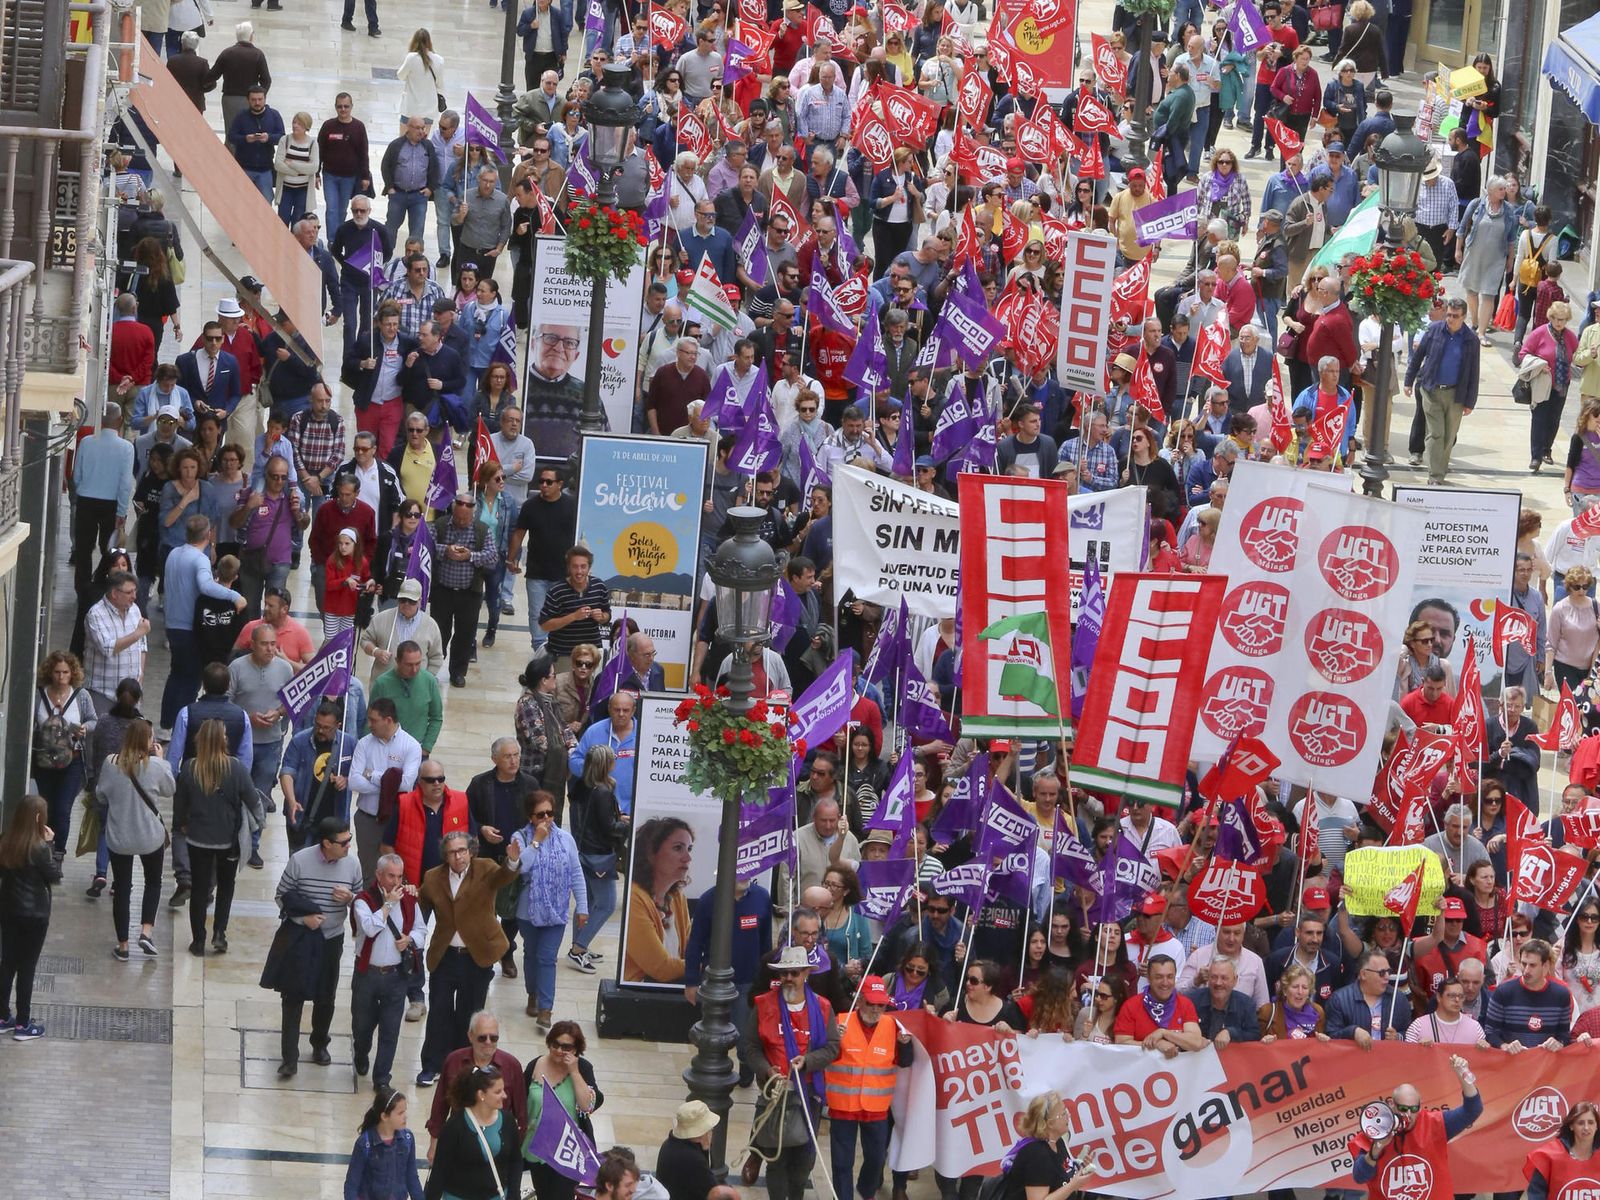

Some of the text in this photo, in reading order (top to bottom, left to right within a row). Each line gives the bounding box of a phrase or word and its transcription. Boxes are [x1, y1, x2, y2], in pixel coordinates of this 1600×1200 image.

[977, 149, 1007, 170] UGT
[544, 277, 580, 287] ACABAR
[582, 279, 594, 288] CO
[542, 297, 572, 307] SALUD
[543, 288, 593, 298] ESTIGMA DE
[1066, 238, 1107, 368] CCOO
[953, 310, 991, 345] CCOO
[962, 337, 982, 357] Málaga
[1066, 367, 1096, 378] málaga
[612, 451, 678, 464] 28 DE ABRIL DE 2018
[616, 473, 670, 490] FESTIVAL
[595, 483, 688, 515] Solidario
[1425, 522, 1489, 533] AUTOESTIMA
[629, 532, 654, 547] Soles
[876, 524, 925, 552] SIN
[1336, 534, 1384, 560] UGT
[1426, 533, 1489, 544] EMPLEO SON
[628, 546, 666, 567] Málaga
[1436, 545, 1500, 556] PARA EVITAR
[1257, 558, 1289, 571] Málaga
[1418, 555, 1477, 567] EXCLUSIÓN”
[903, 581, 932, 594] UNA
[1337, 586, 1369, 600] Málaga
[1238, 589, 1286, 620] UGT
[1322, 615, 1369, 644] UGT
[1236, 643, 1268, 655] Málaga
[1097, 580, 1201, 780] CCOO
[1321, 669, 1352, 683] Málaga
[1216, 674, 1267, 704] UGT
[1305, 698, 1351, 730] UGT
[653, 734, 680, 744] “DAR
[1216, 726, 1248, 739] Málaa
[652, 747, 680, 757] PARA
[1304, 751, 1336, 765] Málaga
[651, 759, 685, 770] MÍA ES
[1205, 864, 1256, 894] UGT
[1201, 908, 1241, 920] Andalucía
[937, 1036, 1019, 1075] mayo
[943, 1061, 1025, 1108] 2018
[1172, 1055, 1311, 1161] ganar
[1276, 1086, 1346, 1123] Igualdad
[1521, 1094, 1562, 1117] UGT
[1293, 1113, 1341, 1139] Mejor
[1094, 1132, 1158, 1179] de
[1390, 1163, 1427, 1186] UGT
